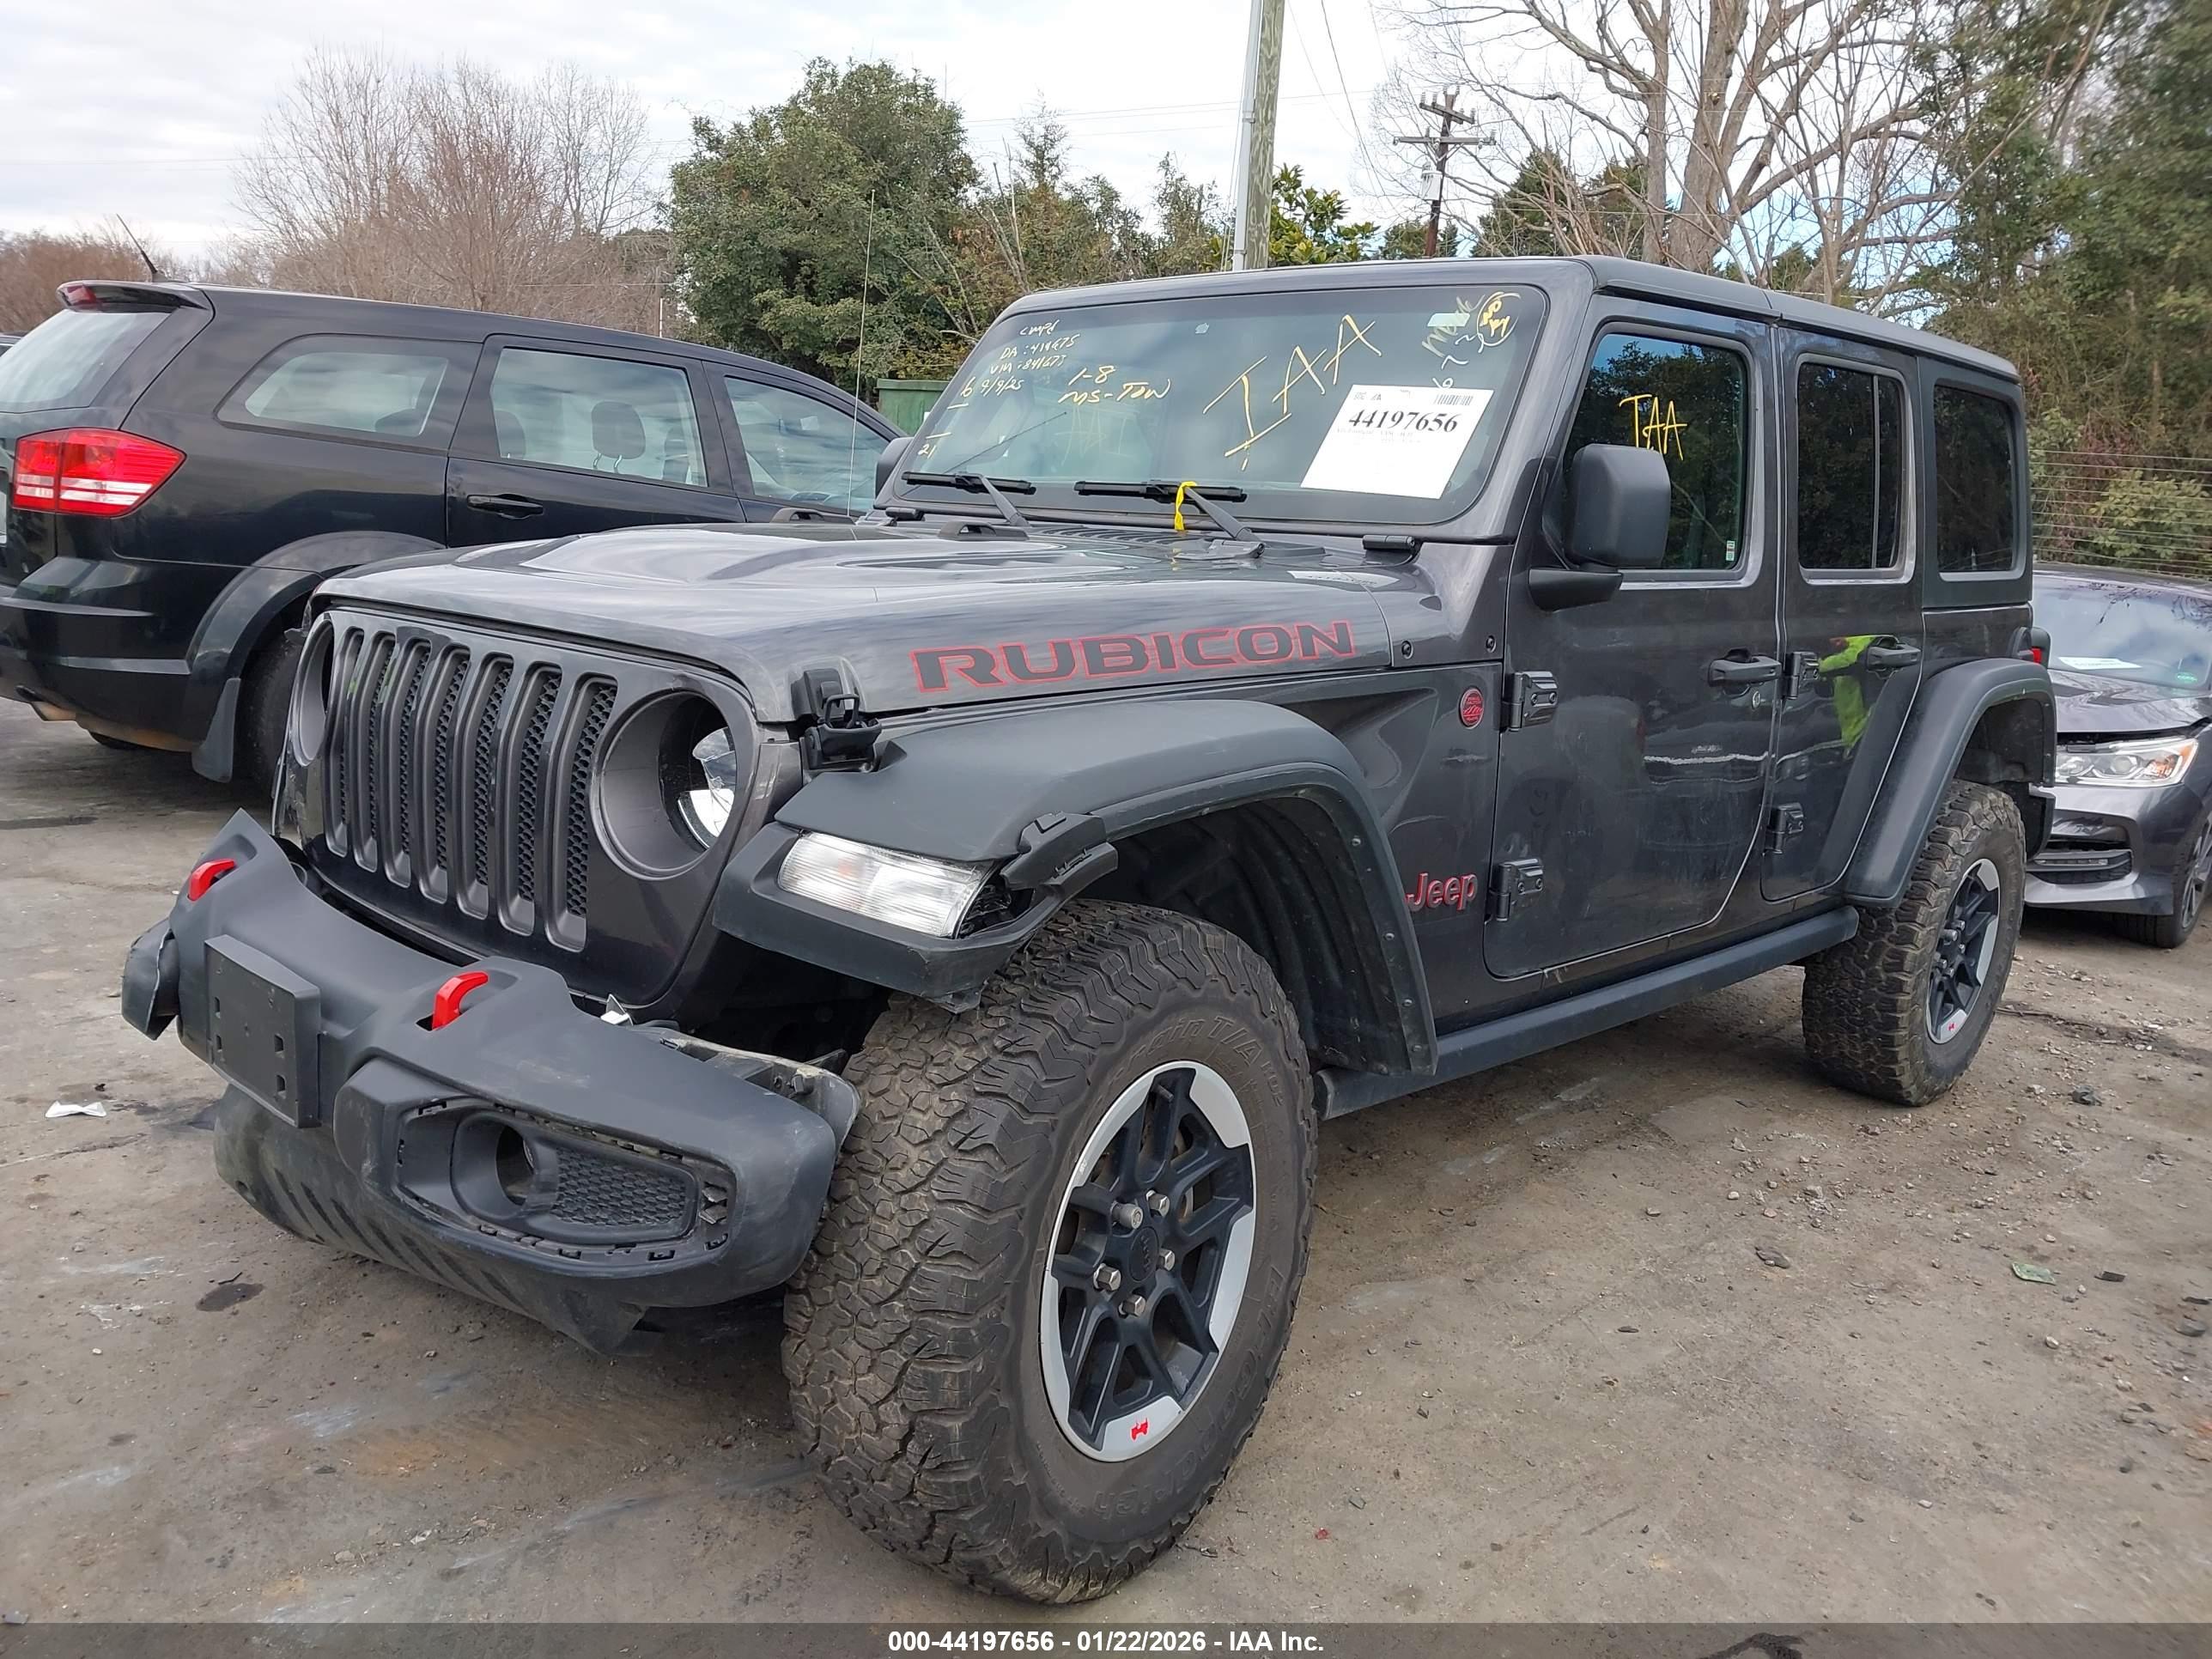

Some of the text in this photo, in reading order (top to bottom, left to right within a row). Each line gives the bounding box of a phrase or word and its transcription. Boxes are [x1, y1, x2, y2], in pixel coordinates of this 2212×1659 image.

[1202, 313, 1382, 458] IAA
[1348, 409, 1462, 433] 44197656
[908, 619, 1356, 693] RUBICON
[1404, 872, 1478, 913] Jeep
